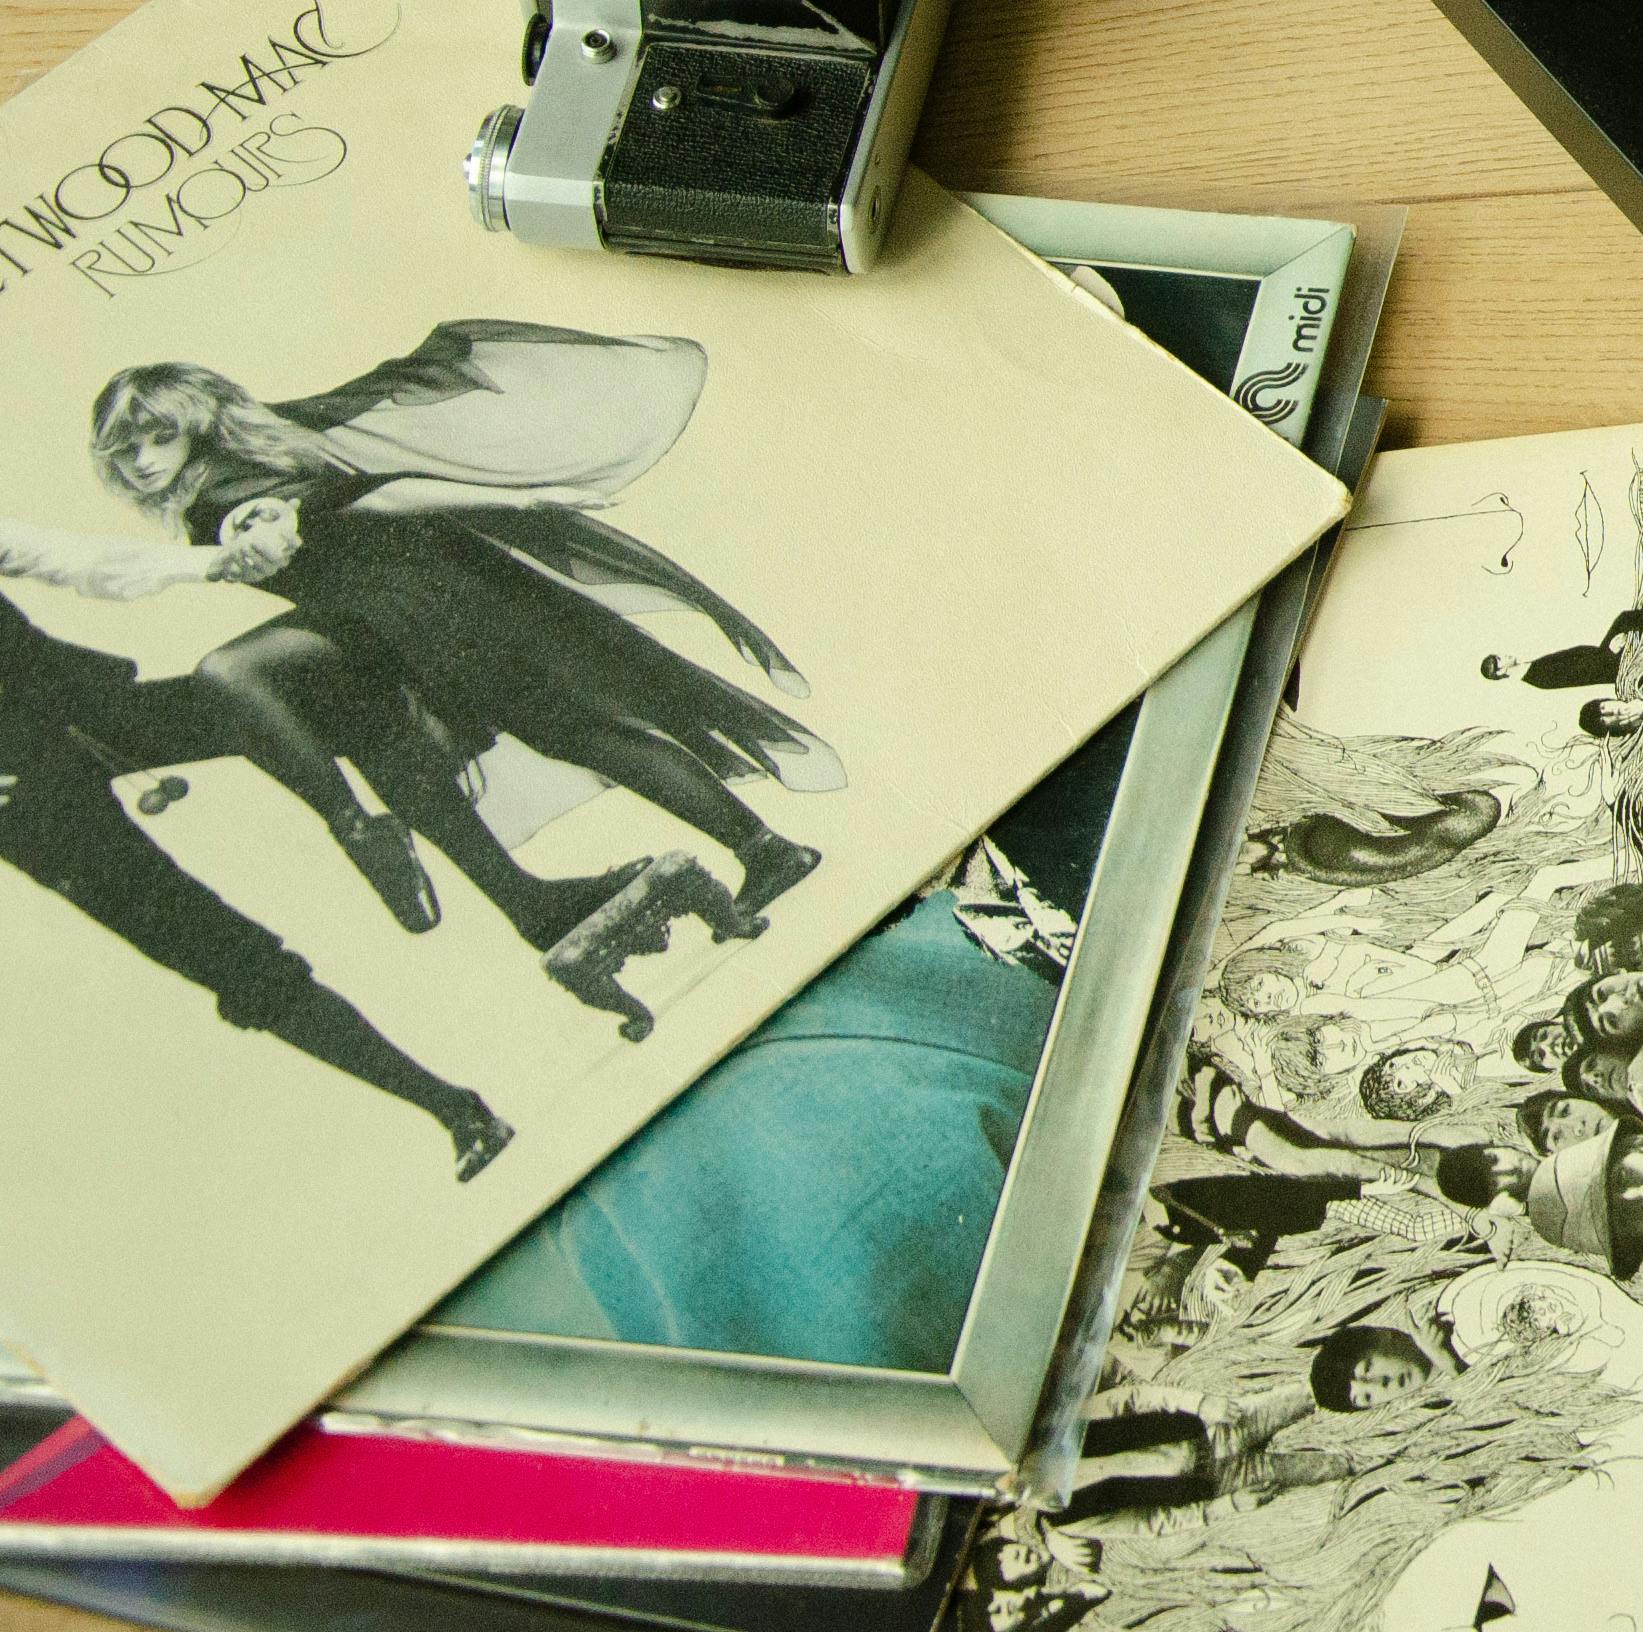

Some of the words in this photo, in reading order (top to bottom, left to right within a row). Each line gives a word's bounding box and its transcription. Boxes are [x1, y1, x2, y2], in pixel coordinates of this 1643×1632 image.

[0, 106, 214, 292] TWOOD
[68, 111, 348, 300] RUMOURS
[1289, 286, 1330, 353] midi
